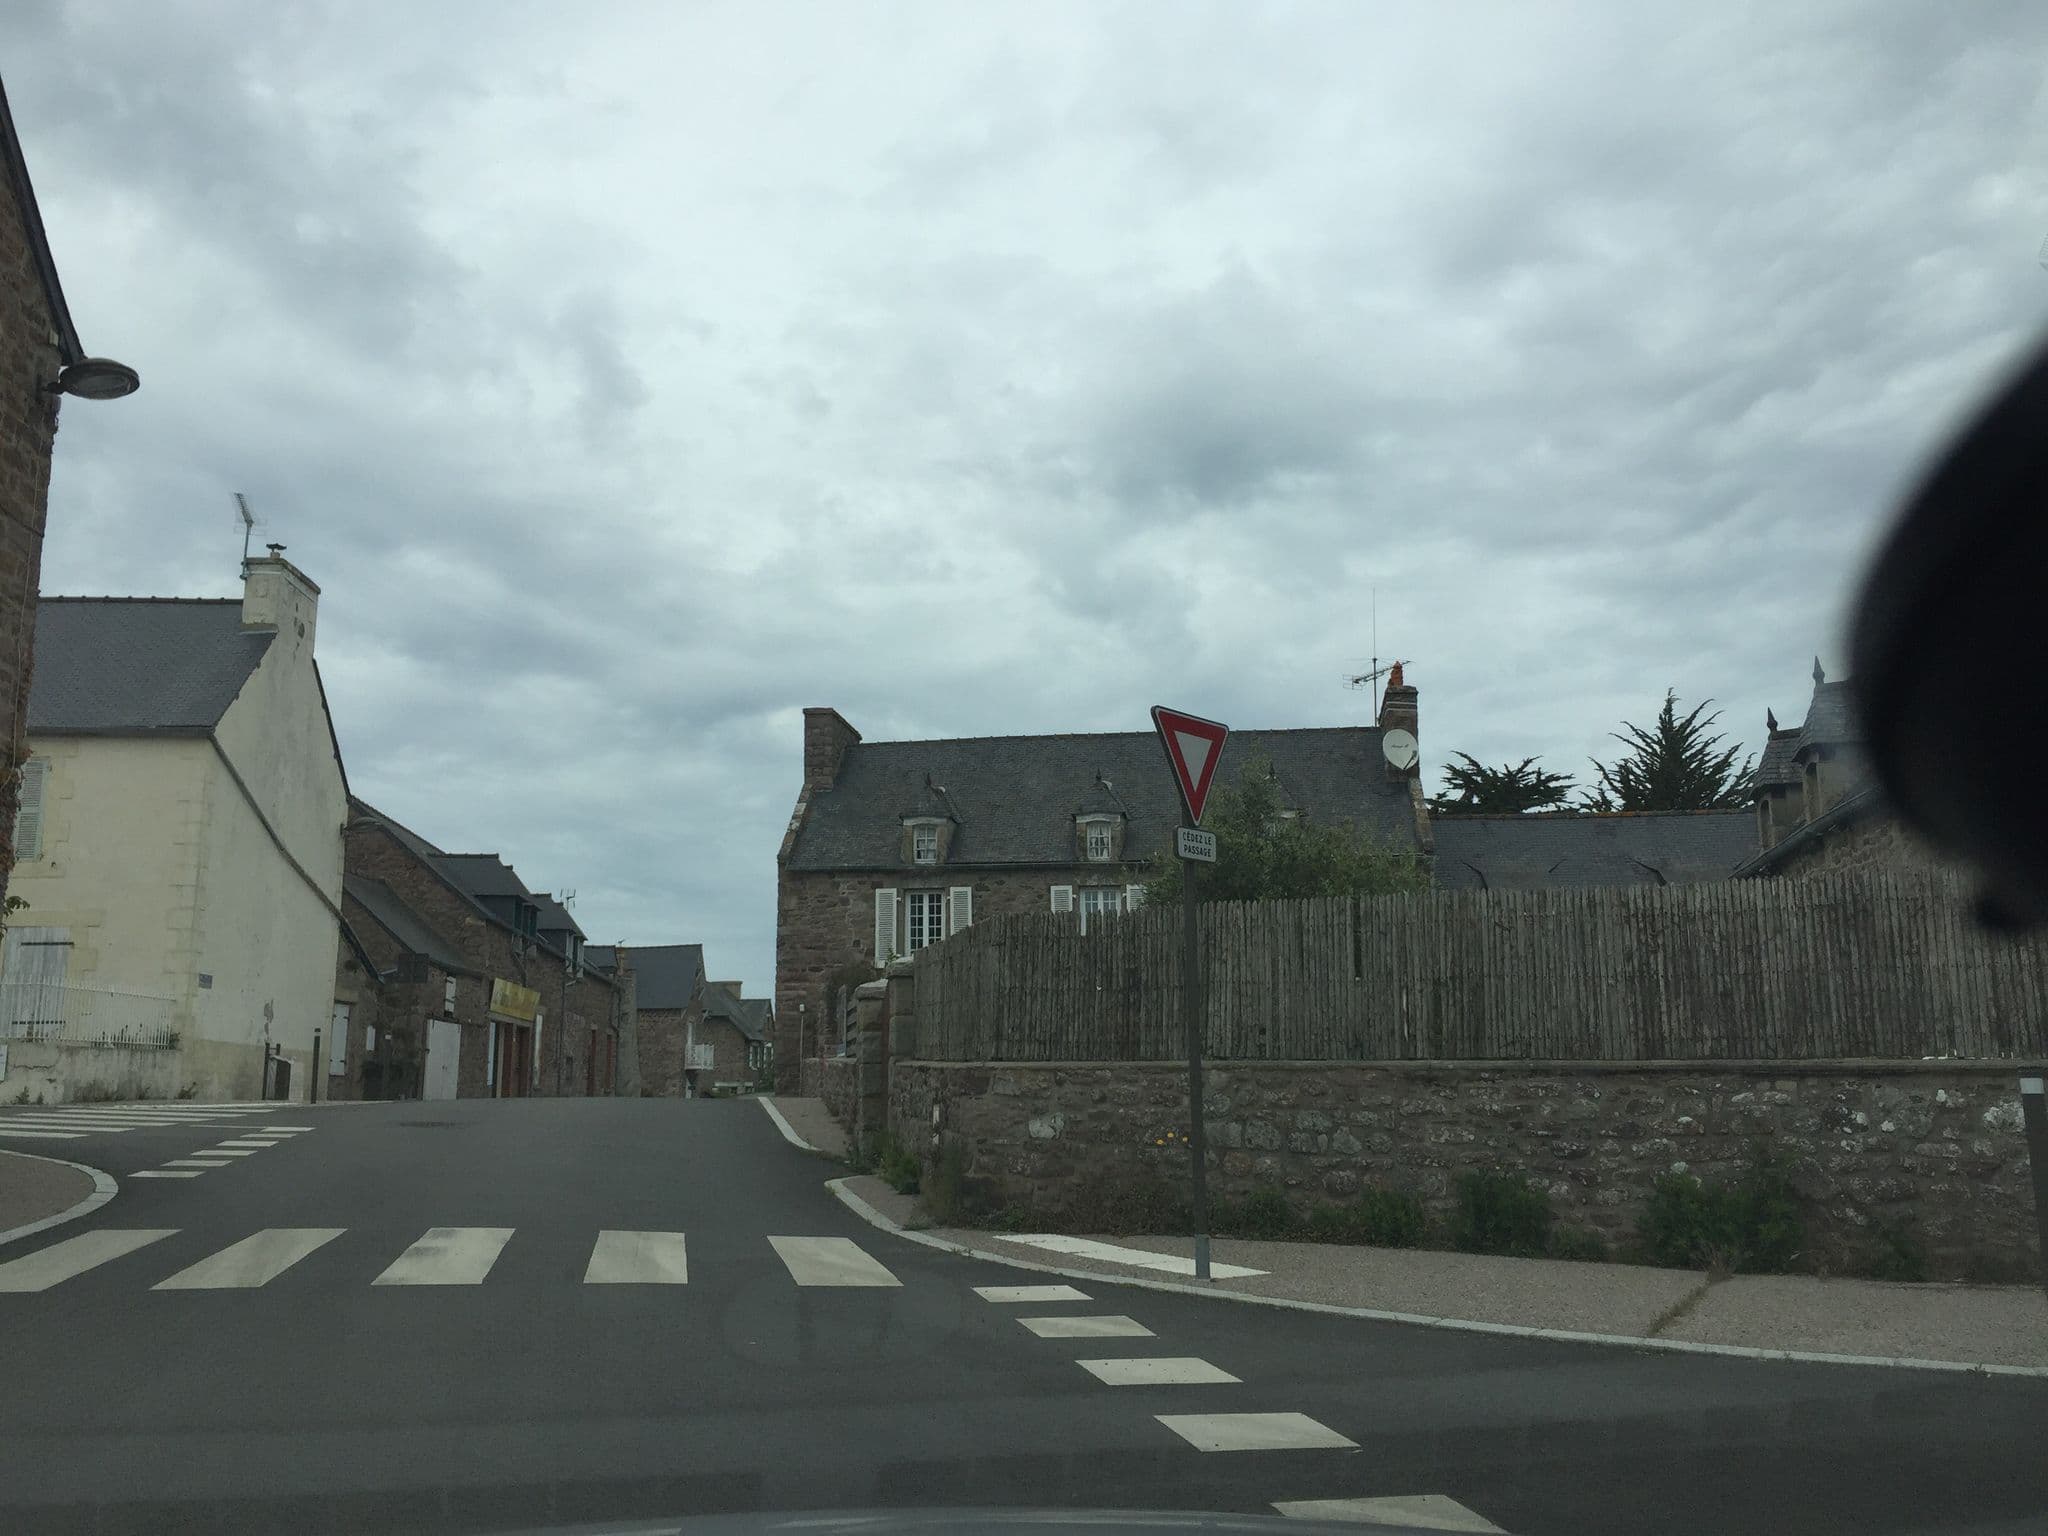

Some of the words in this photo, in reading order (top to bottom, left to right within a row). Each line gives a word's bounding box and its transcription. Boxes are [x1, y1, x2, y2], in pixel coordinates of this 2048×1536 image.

[1183, 831, 1203, 844] CÉDEZ
[1204, 836, 1212, 846] LE
[1183, 844, 1212, 858] PASSAGE
